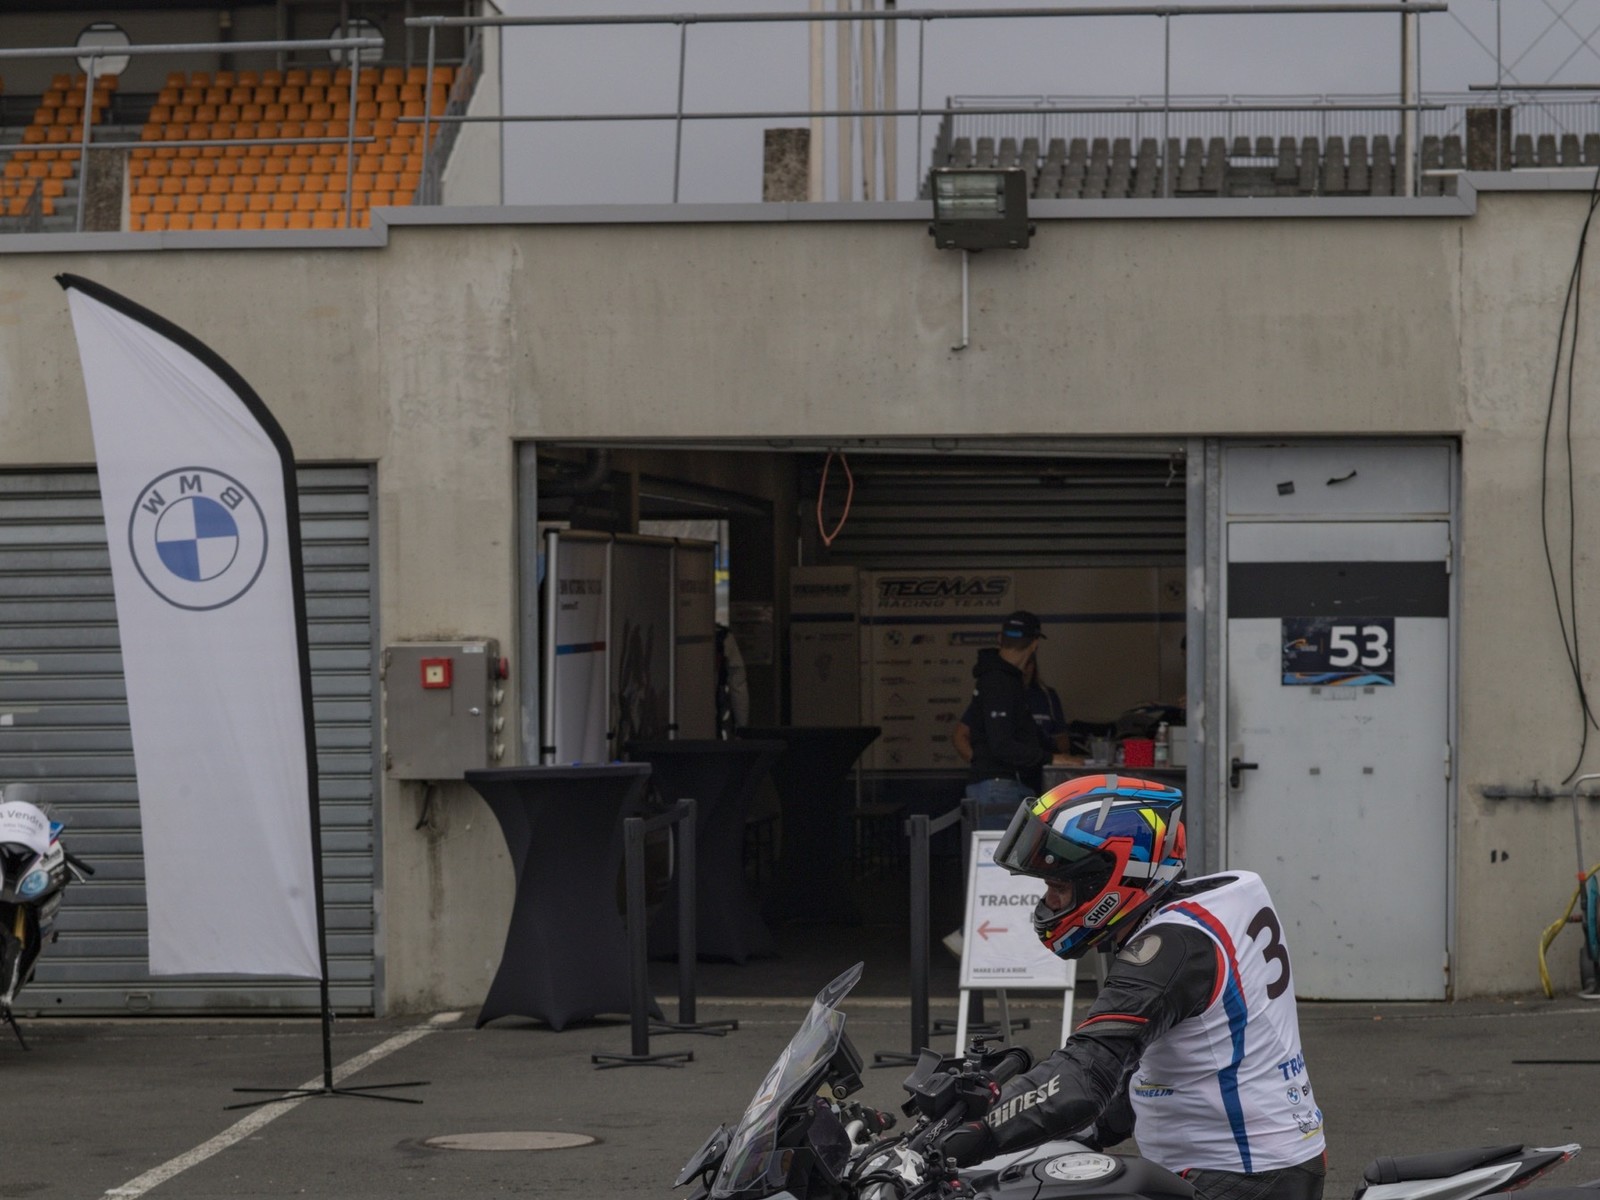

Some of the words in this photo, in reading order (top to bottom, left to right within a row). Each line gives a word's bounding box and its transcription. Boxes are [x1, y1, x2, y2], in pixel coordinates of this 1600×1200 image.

[878, 599, 945, 608] RACING
[954, 599, 1002, 608] TEAM
[879, 579, 1008, 596] TECMAS
[1329, 625, 1389, 667] 53
[1087, 896, 1117, 925] SHOEI
[1246, 906, 1290, 1000] 3
[987, 1074, 1060, 1128] AINESE
